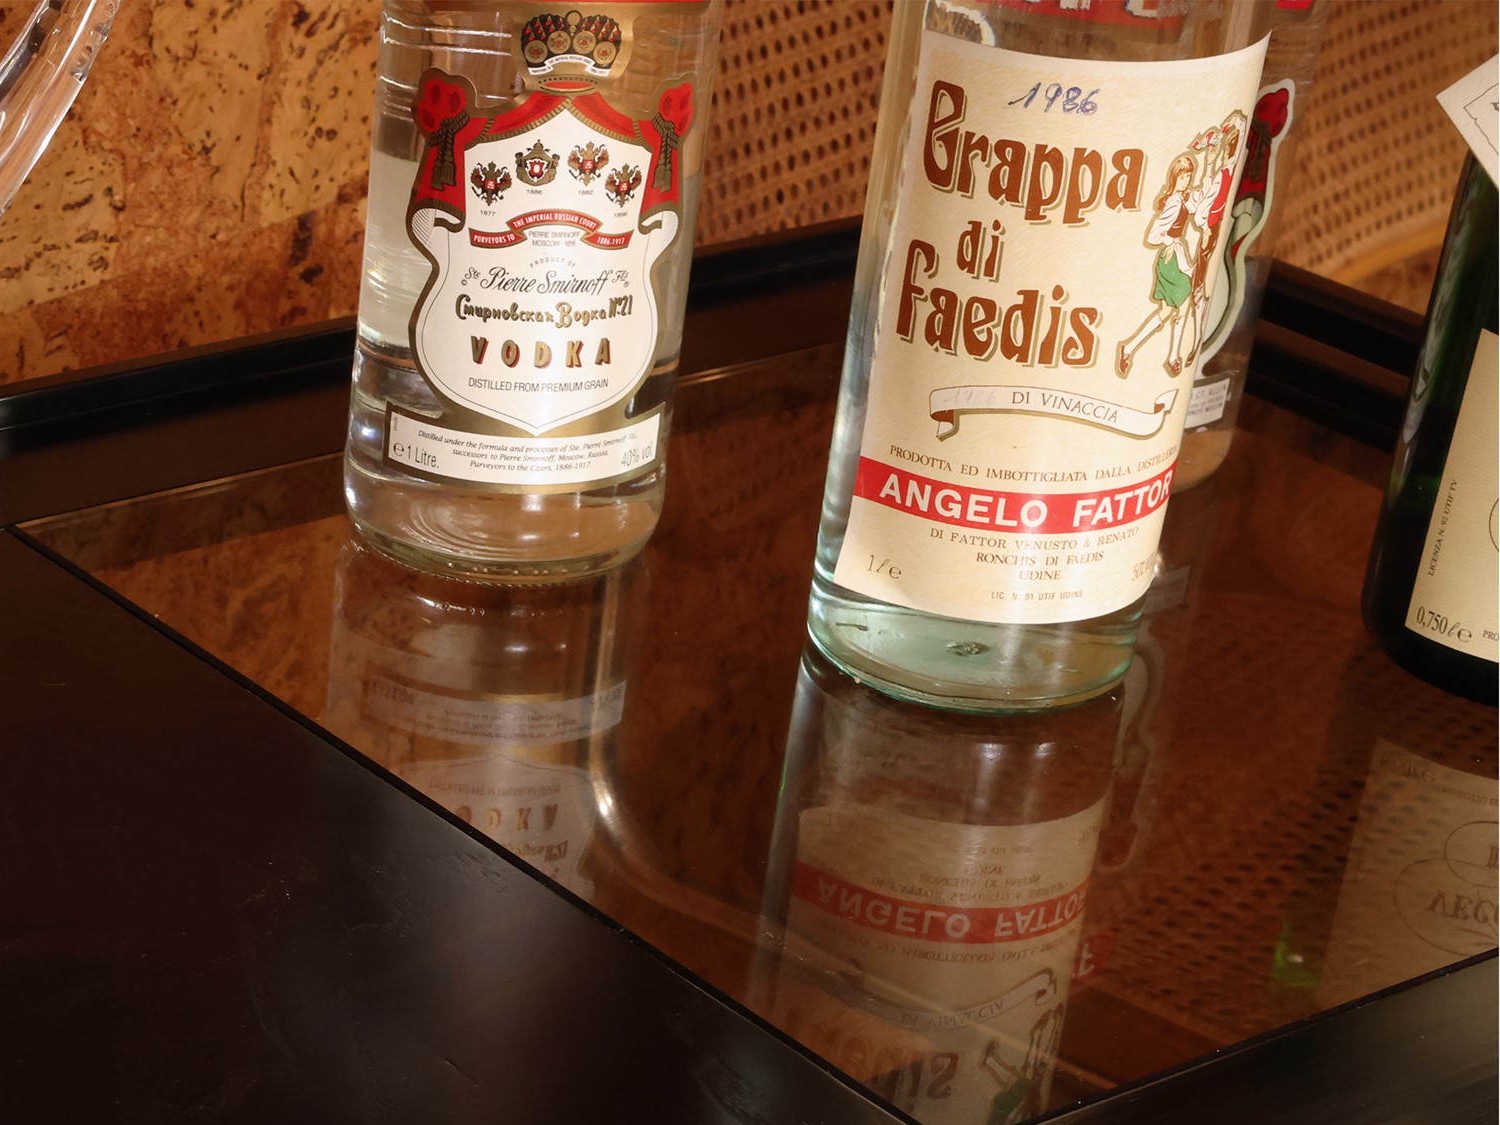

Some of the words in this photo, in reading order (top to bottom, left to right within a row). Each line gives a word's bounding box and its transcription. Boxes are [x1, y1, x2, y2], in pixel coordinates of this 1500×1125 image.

[1007, 81, 1101, 116] 1986
[923, 80, 1147, 226] Grappa
[512, 218, 526, 229] THE
[525, 212, 553, 224] IMPERIAL
[554, 212, 579, 223] RUSSIAN
[578, 217, 597, 230] COURT
[473, 234, 507, 244] PURVEYORS
[506, 233, 516, 242] TO
[528, 230, 551, 239] PIERRE
[551, 230, 581, 239] SMIRNOFF
[531, 239, 561, 247] MOSCOW
[530, 256, 565, 269] PRODUCT
[567, 259, 578, 269] OF
[956, 219, 1006, 283] di
[480, 266, 537, 293] Pierre
[536, 270, 614, 295] Smirnoff
[896, 238, 1103, 369] Faedis
[470, 335, 612, 369] VODKA
[468, 377, 513, 392] DISTILLED
[513, 381, 540, 393] FROM
[541, 381, 584, 393] PREMIUM
[583, 378, 610, 391] GRAIN
[1011, 391, 1031, 405] DI
[1040, 392, 1120, 423] VINACCIA
[418, 429, 444, 443] Distilled
[444, 437, 465, 447] under
[466, 440, 478, 449] the
[477, 442, 508, 452] formula
[509, 443, 525, 453] and
[525, 446, 559, 454] processes
[560, 443, 569, 453] of
[583, 441, 602, 450] Pierre
[414, 446, 439, 469] Litre.
[452, 447, 488, 460] successors
[490, 452, 498, 460] to
[499, 453, 522, 462] Pierre
[469, 460, 506, 472] Purveyors
[507, 463, 515, 472] to
[516, 463, 529, 472] the
[889, 444, 953, 472] PRODOTTA
[960, 463, 980, 477] ED
[985, 467, 1088, 483] IMBOTTIGLIATA
[1094, 465, 1132, 481] DALLA
[878, 473, 1048, 529] ANGELO
[1071, 469, 1173, 528] FATTOR
[930, 527, 944, 540] DI
[949, 531, 1008, 549] FATTOR
[1014, 538, 1079, 552] VENUSTO
[1083, 539, 1092, 548] &
[1096, 526, 1141, 547] RENATO
[1428, 538, 1443, 577] LICENZA
[1440, 515, 1449, 527] 92
[975, 552, 1037, 567] RONCHIS
[1045, 554, 1060, 567] DI
[1066, 550, 1106, 565] FAEDIS
[1018, 569, 1063, 582] UDINE
[1024, 591, 1036, 601] 91
[1037, 590, 1057, 601] UTIF
[1059, 589, 1084, 600] UDINE
[1416, 606, 1449, 635] 0,750
